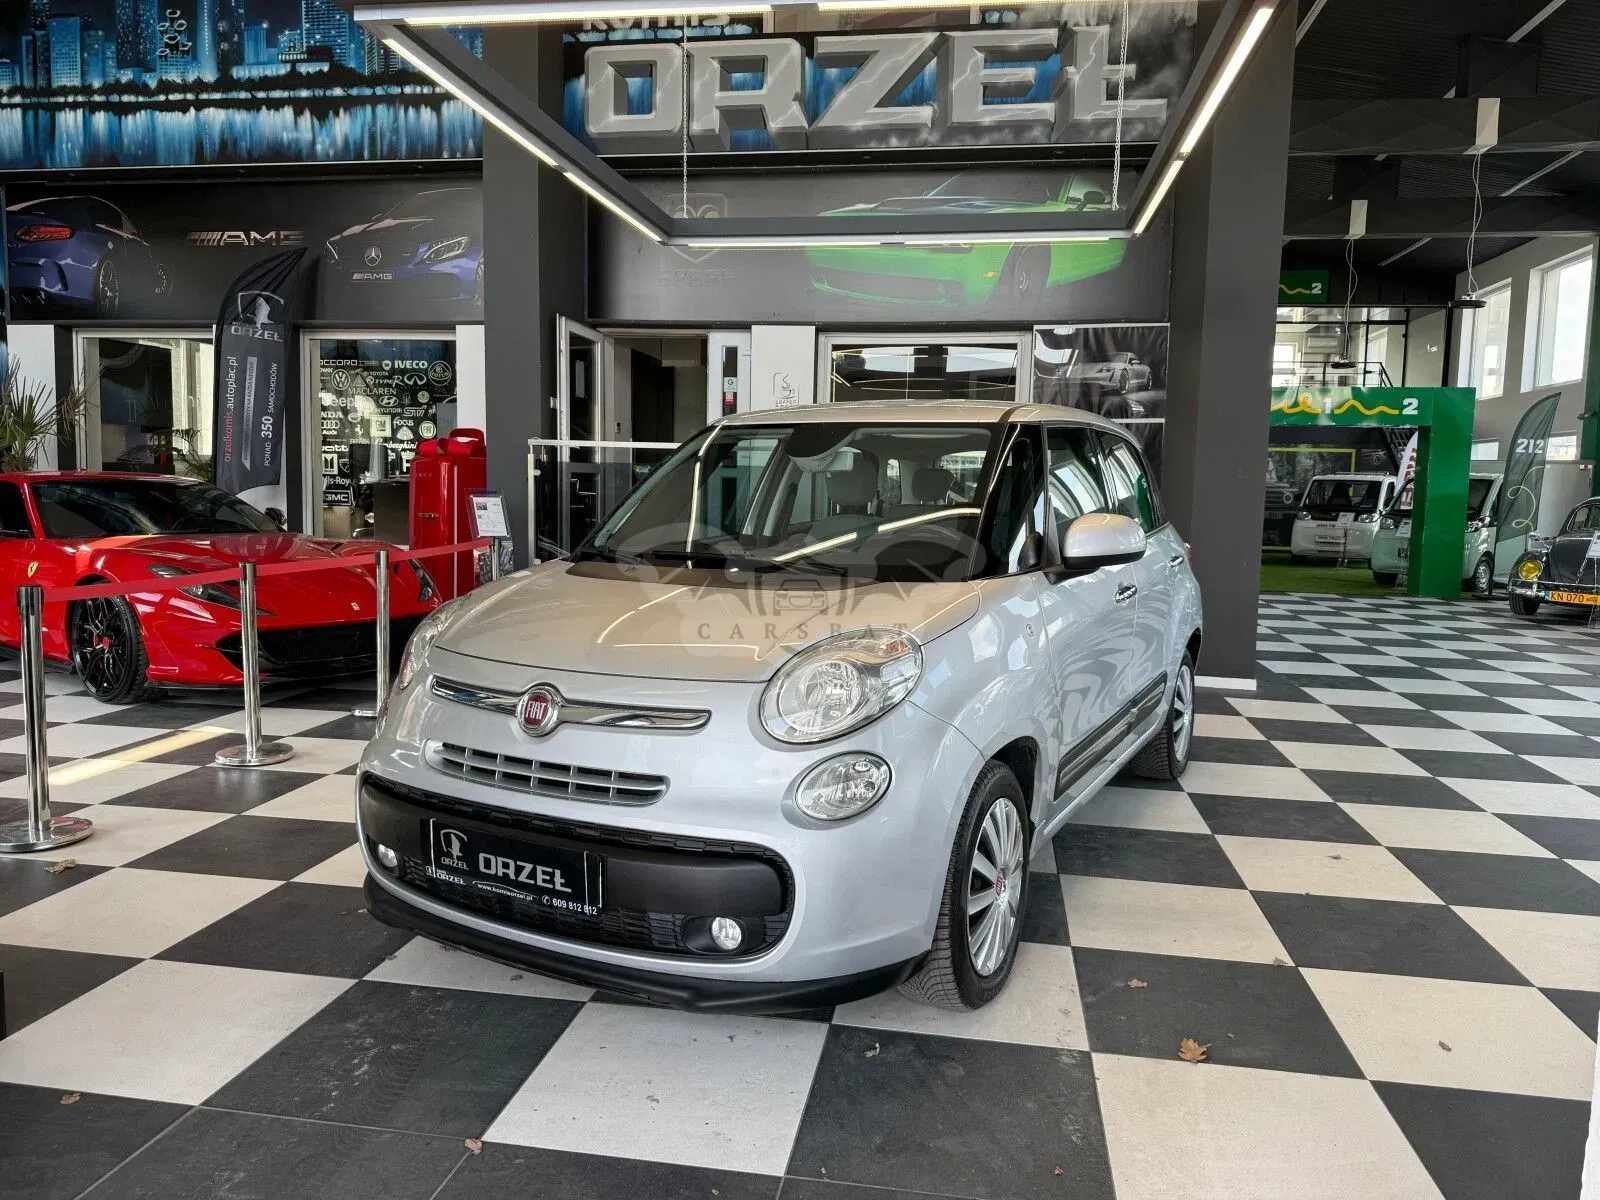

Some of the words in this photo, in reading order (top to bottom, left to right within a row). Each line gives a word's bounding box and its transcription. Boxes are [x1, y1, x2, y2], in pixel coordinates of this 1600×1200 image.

[584, 27, 1169, 148] ORZEŁ
[363, 272, 393, 281] AMG
[394, 360, 428, 369] IVECO
[268, 362, 278, 413] SAMOCHODÓW
[348, 387, 397, 395] MACLAREN
[1402, 397, 1419, 415] 2
[261, 416, 273, 438] 350
[374, 437, 418, 452] Lborghini
[1515, 438, 1545, 454] 212
[264, 442, 272, 466] PONAD
[1551, 592, 1563, 600] KN
[1566, 594, 1585, 602] 070
[525, 700, 547, 720] FIAT
[479, 852, 572, 893] ORZEŁ
[552, 898, 567, 909] 609
[568, 901, 582, 912] 812
[583, 904, 598, 915] 812
